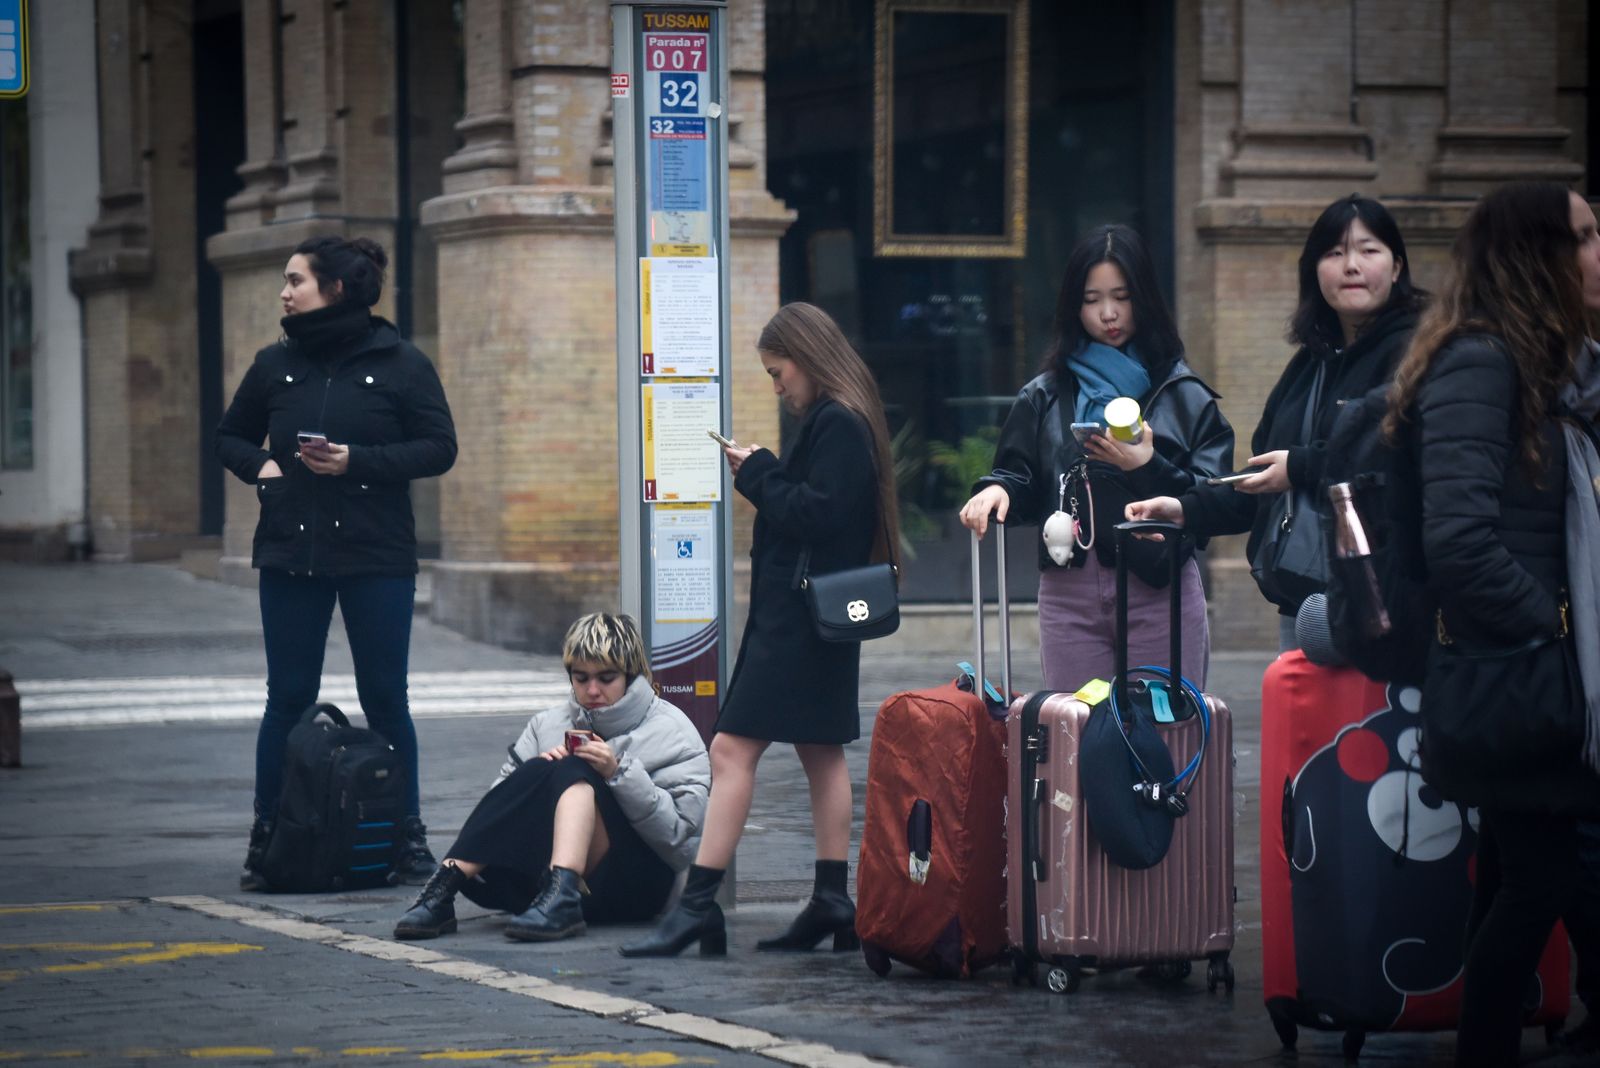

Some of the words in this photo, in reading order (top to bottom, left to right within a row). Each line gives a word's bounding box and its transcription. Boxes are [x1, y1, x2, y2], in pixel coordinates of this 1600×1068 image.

[644, 14, 709, 28] TUSSAM
[648, 37, 691, 47] Parada
[662, 80, 698, 107] 32
[652, 120, 675, 134] 32
[662, 685, 693, 693] TUSSAM
